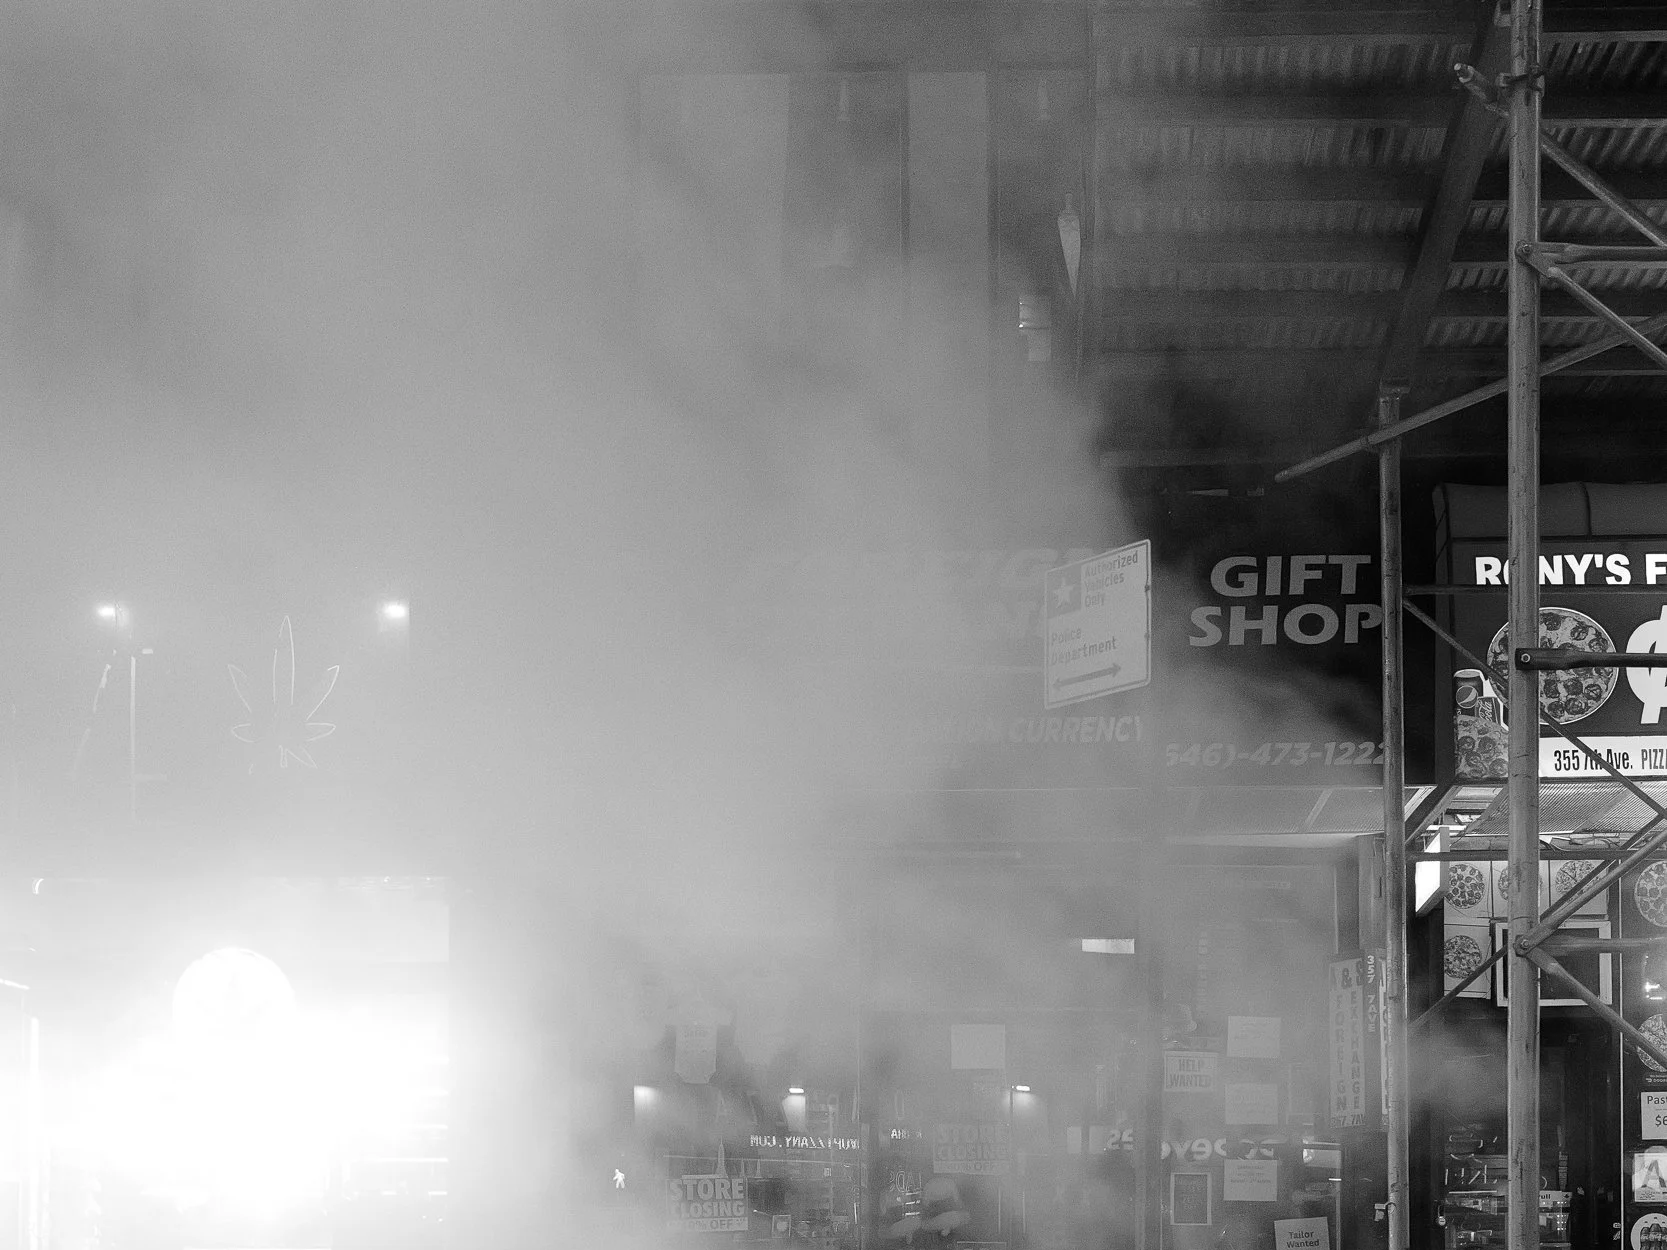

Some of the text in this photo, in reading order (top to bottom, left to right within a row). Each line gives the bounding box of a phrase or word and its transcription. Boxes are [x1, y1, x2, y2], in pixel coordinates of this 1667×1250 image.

[1084, 551, 1139, 577] Authorized
[1084, 572, 1125, 592] Vehicles
[1210, 554, 1371, 597] GIFT
[1084, 593, 1106, 608] Only
[1188, 603, 1383, 647] SHOP
[1051, 628, 1082, 646] Police
[1051, 635, 1118, 667] Department
[1553, 749, 1580, 772] 355
[1606, 748, 1633, 770] Ave.
[1640, 748, 1667, 770] PIZZ
[1647, 1095, 1667, 1105] Pas
[669, 1178, 745, 1201] STORE
[670, 1200, 746, 1218] CLOSING
[709, 1219, 734, 1230] OFF
[1286, 1240, 1320, 1249] Wanted
[1288, 1230, 1315, 1240] Tailor
